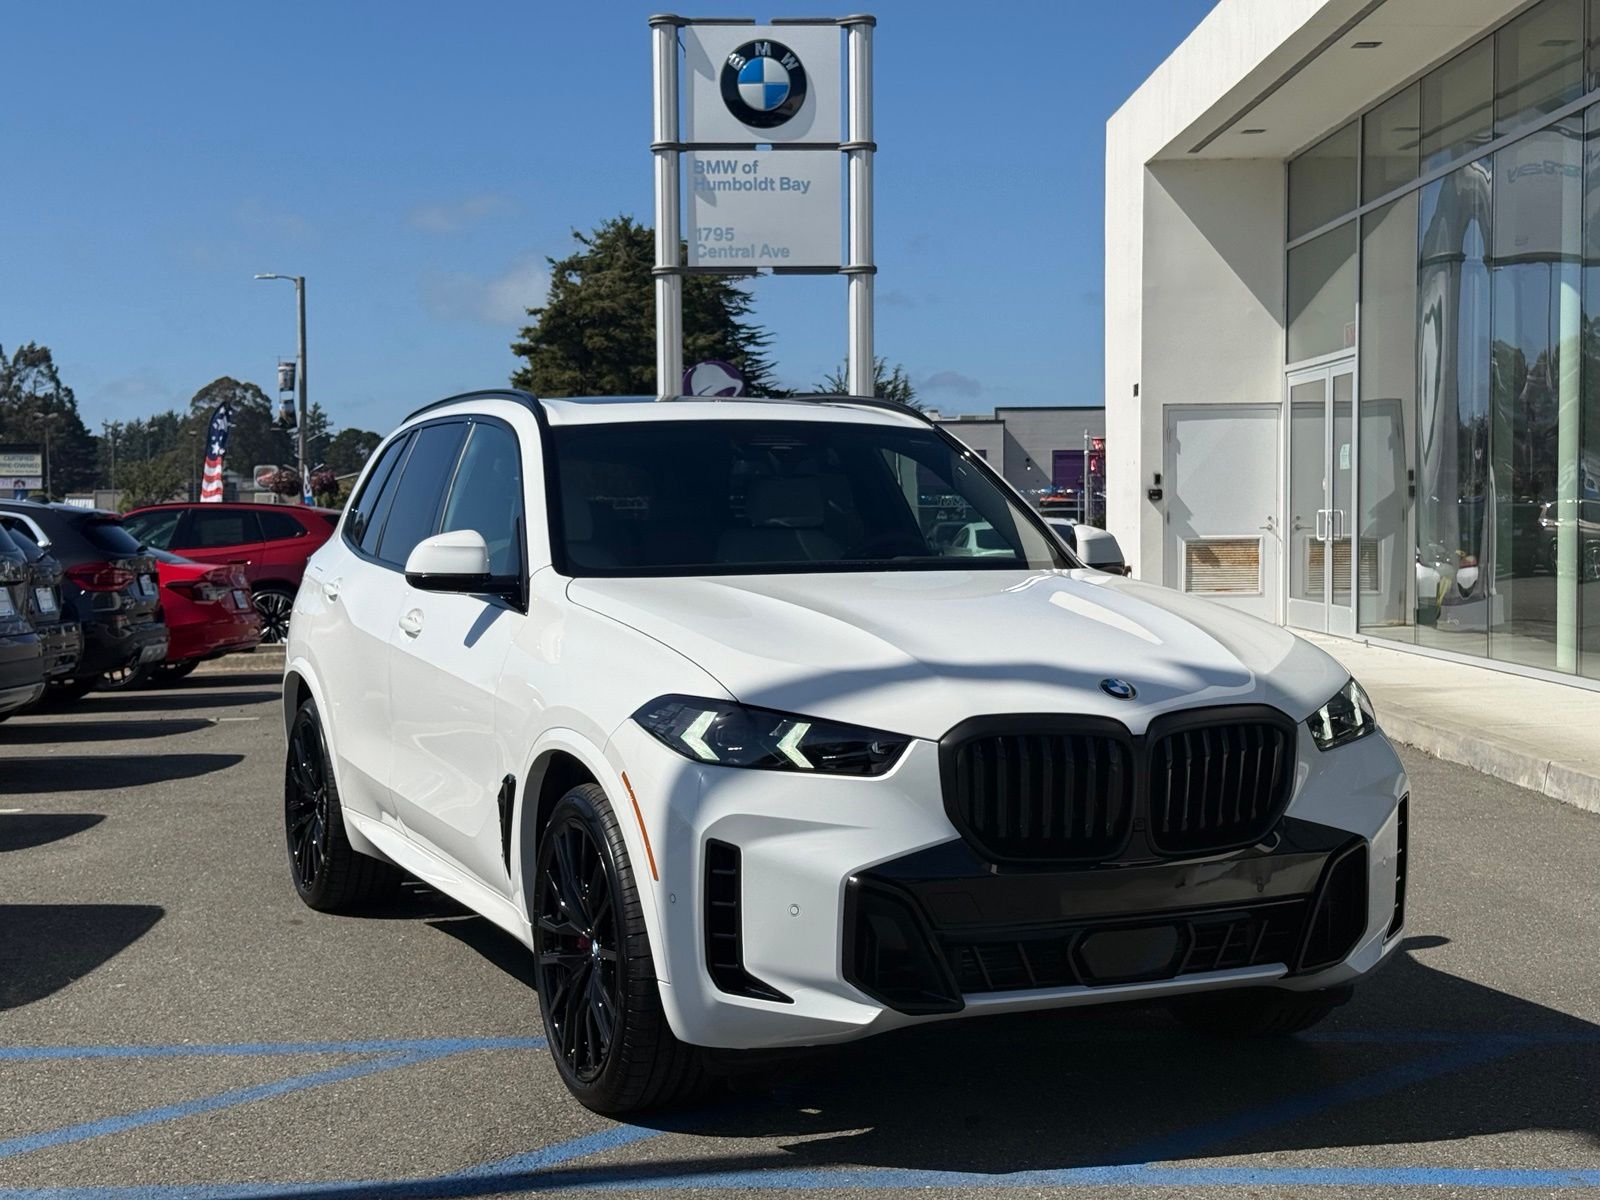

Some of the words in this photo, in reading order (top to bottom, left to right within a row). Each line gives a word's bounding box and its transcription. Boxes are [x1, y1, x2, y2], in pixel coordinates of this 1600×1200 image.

[728, 41, 799, 71] BMW
[694, 160, 737, 174] BMW
[742, 159, 759, 174] of
[694, 176, 776, 191] Humboldt
[780, 176, 811, 195] Bay
[696, 227, 735, 242] 1795
[697, 243, 755, 258] Central
[759, 243, 791, 258] Ave
